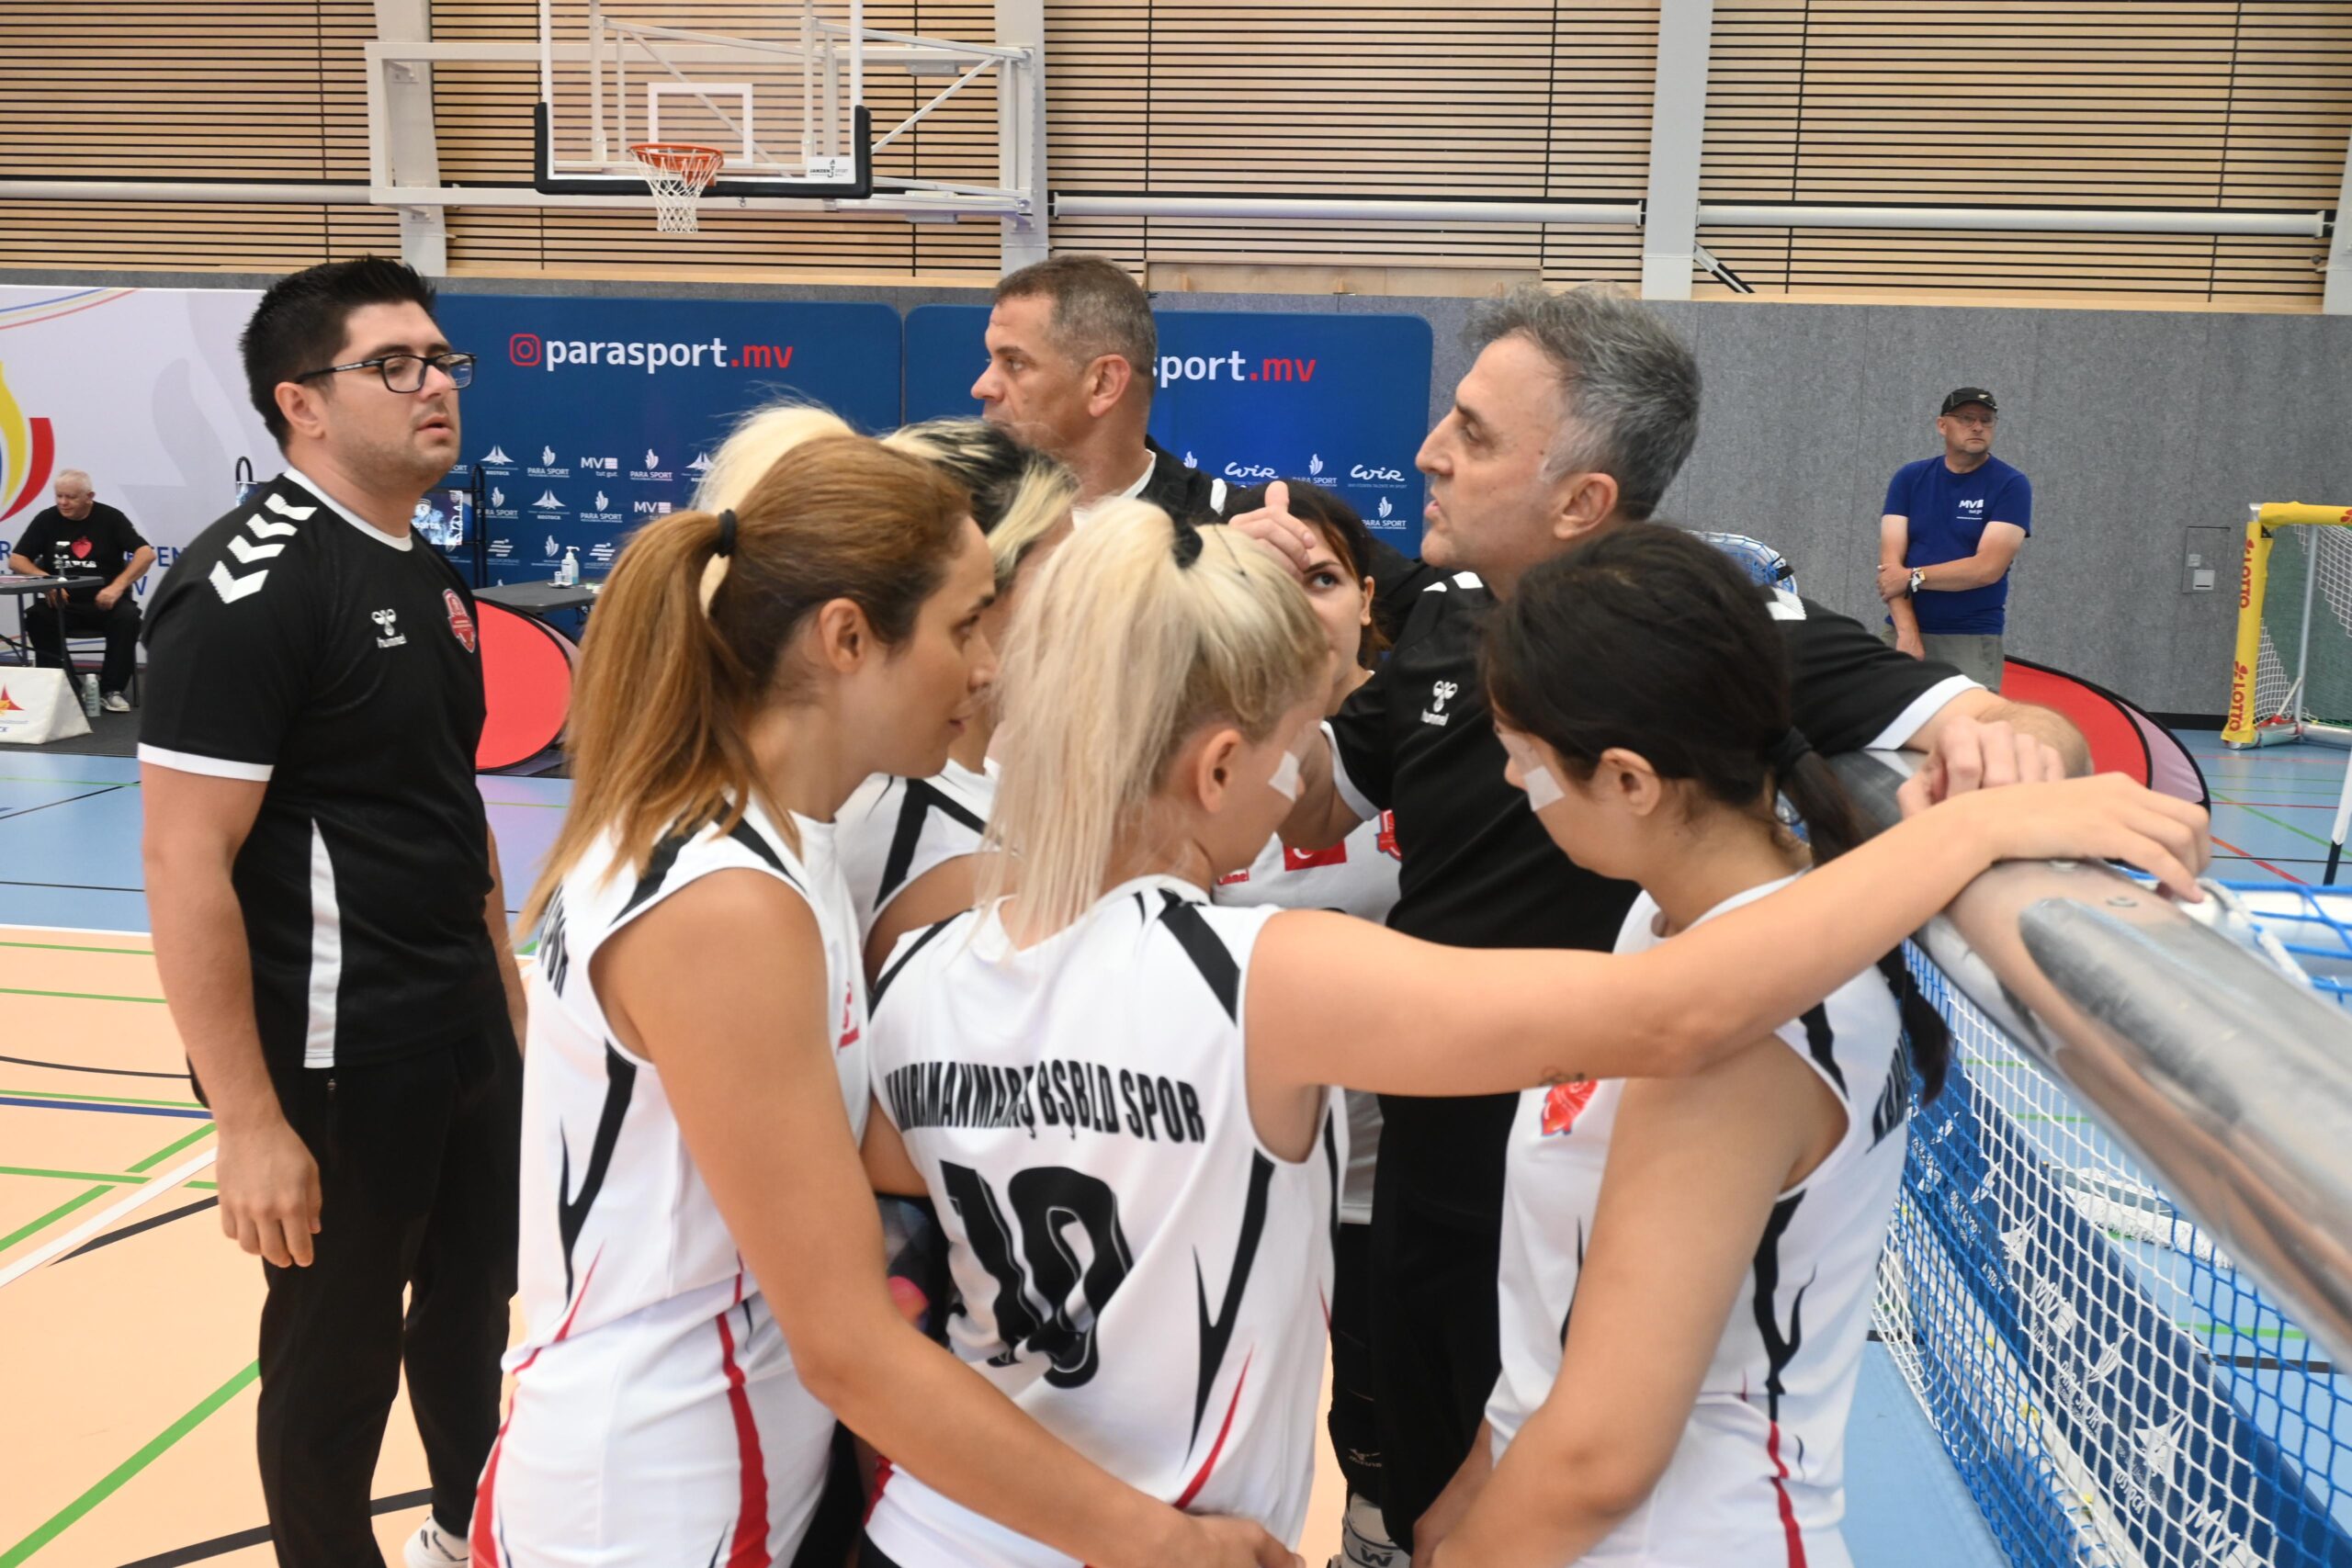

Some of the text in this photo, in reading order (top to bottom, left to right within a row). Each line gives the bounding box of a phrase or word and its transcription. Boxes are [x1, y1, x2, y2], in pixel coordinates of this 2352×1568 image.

[546, 337, 794, 375] parasport.mv
[527, 467, 548, 475] PARA
[548, 468, 570, 476] SPORT
[581, 457, 604, 469] MV
[630, 470, 650, 479] PARA
[651, 471, 673, 479] SPORT
[634, 502, 657, 513] MV
[2239, 557, 2255, 609] LOTTO
[2229, 682, 2246, 732] LOTTO
[1119, 1068, 1205, 1144] SPOR
[939, 1159, 1135, 1389] 10
